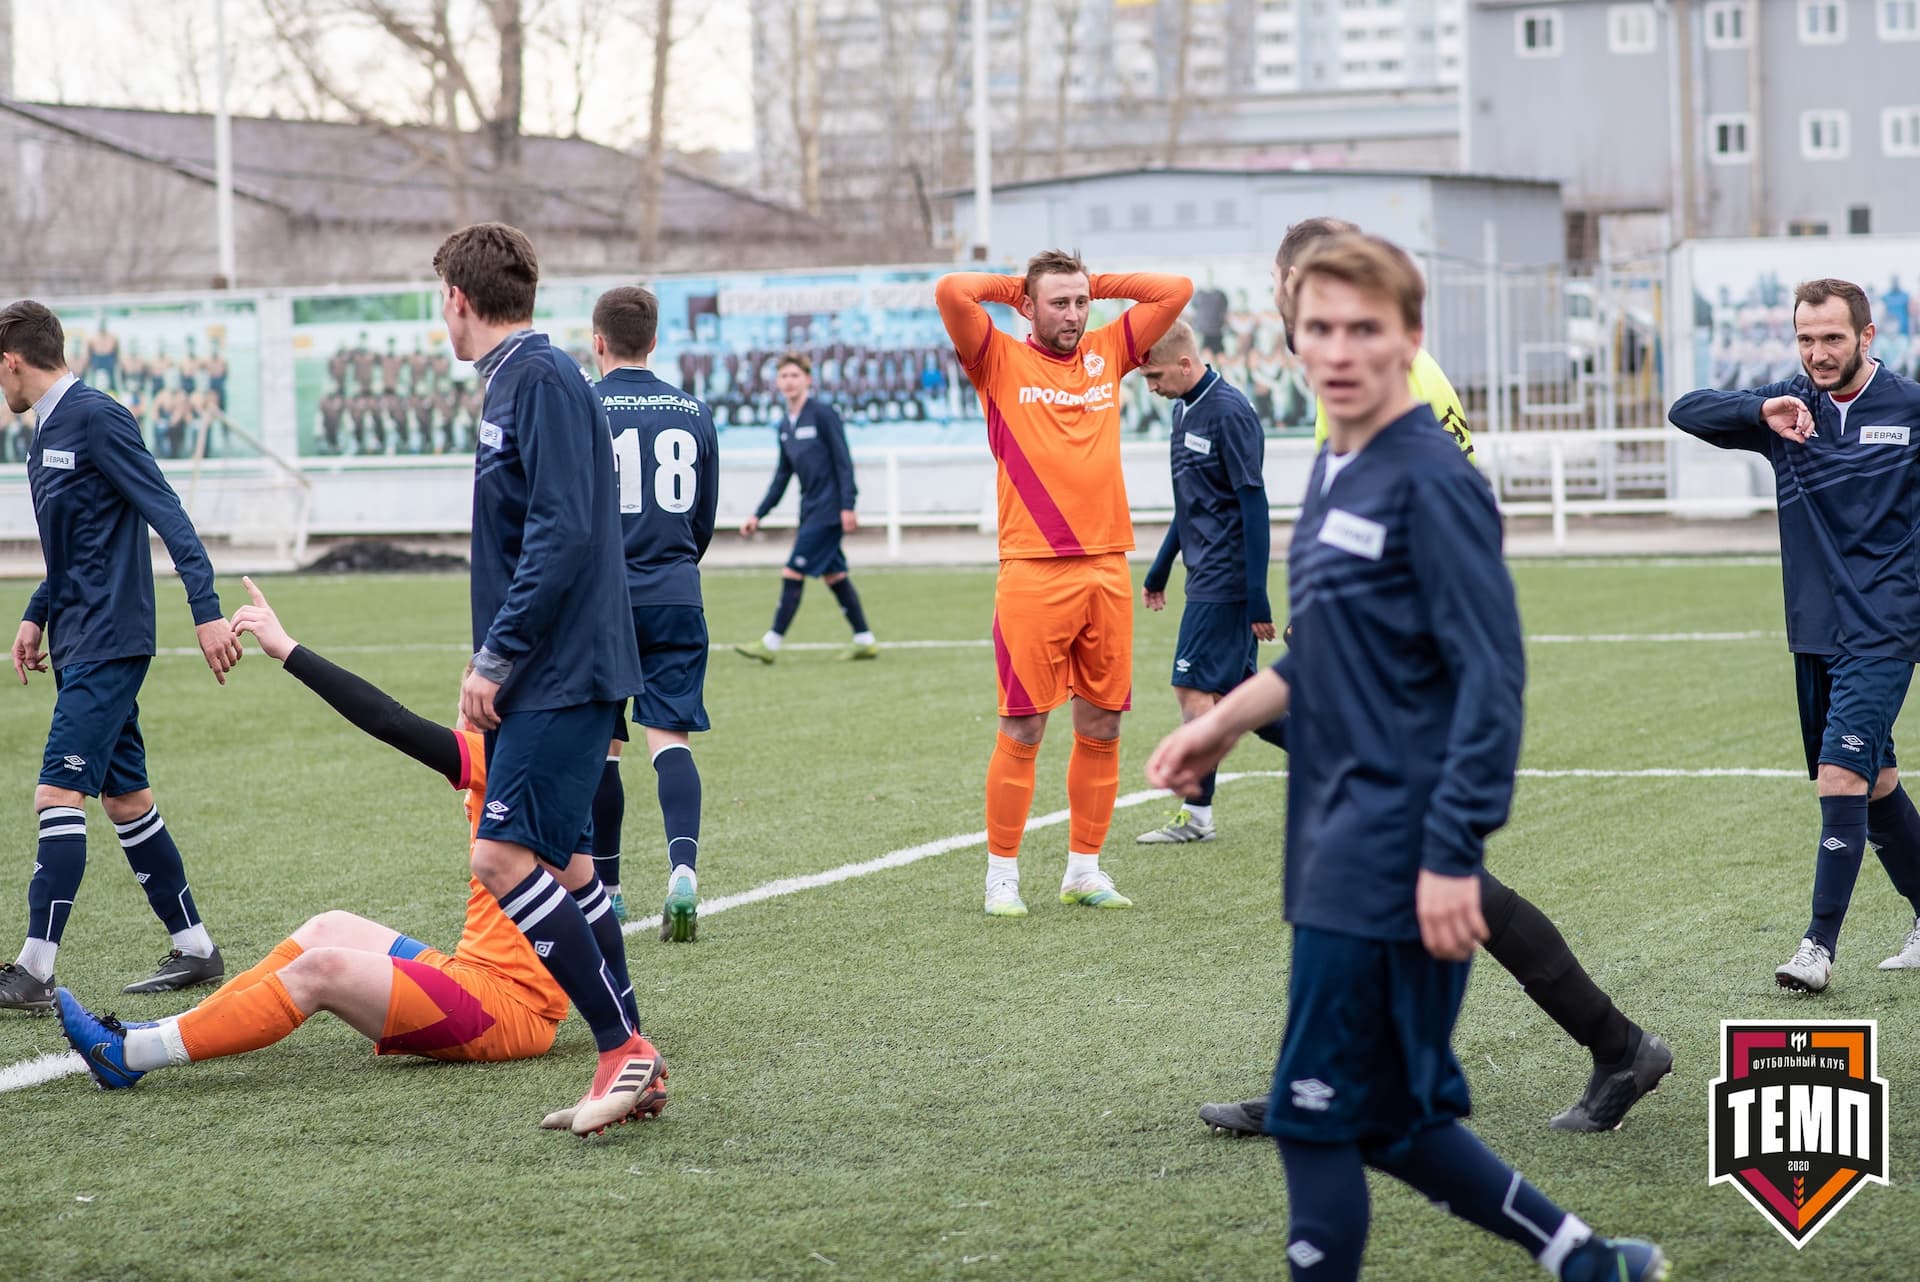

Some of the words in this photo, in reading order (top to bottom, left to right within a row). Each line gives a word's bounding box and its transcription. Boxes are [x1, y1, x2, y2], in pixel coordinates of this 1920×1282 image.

[600, 394, 699, 412] АСПАДСКАЯ
[1873, 431, 1903, 440] ЕВРАЗ
[612, 427, 698, 514] 18
